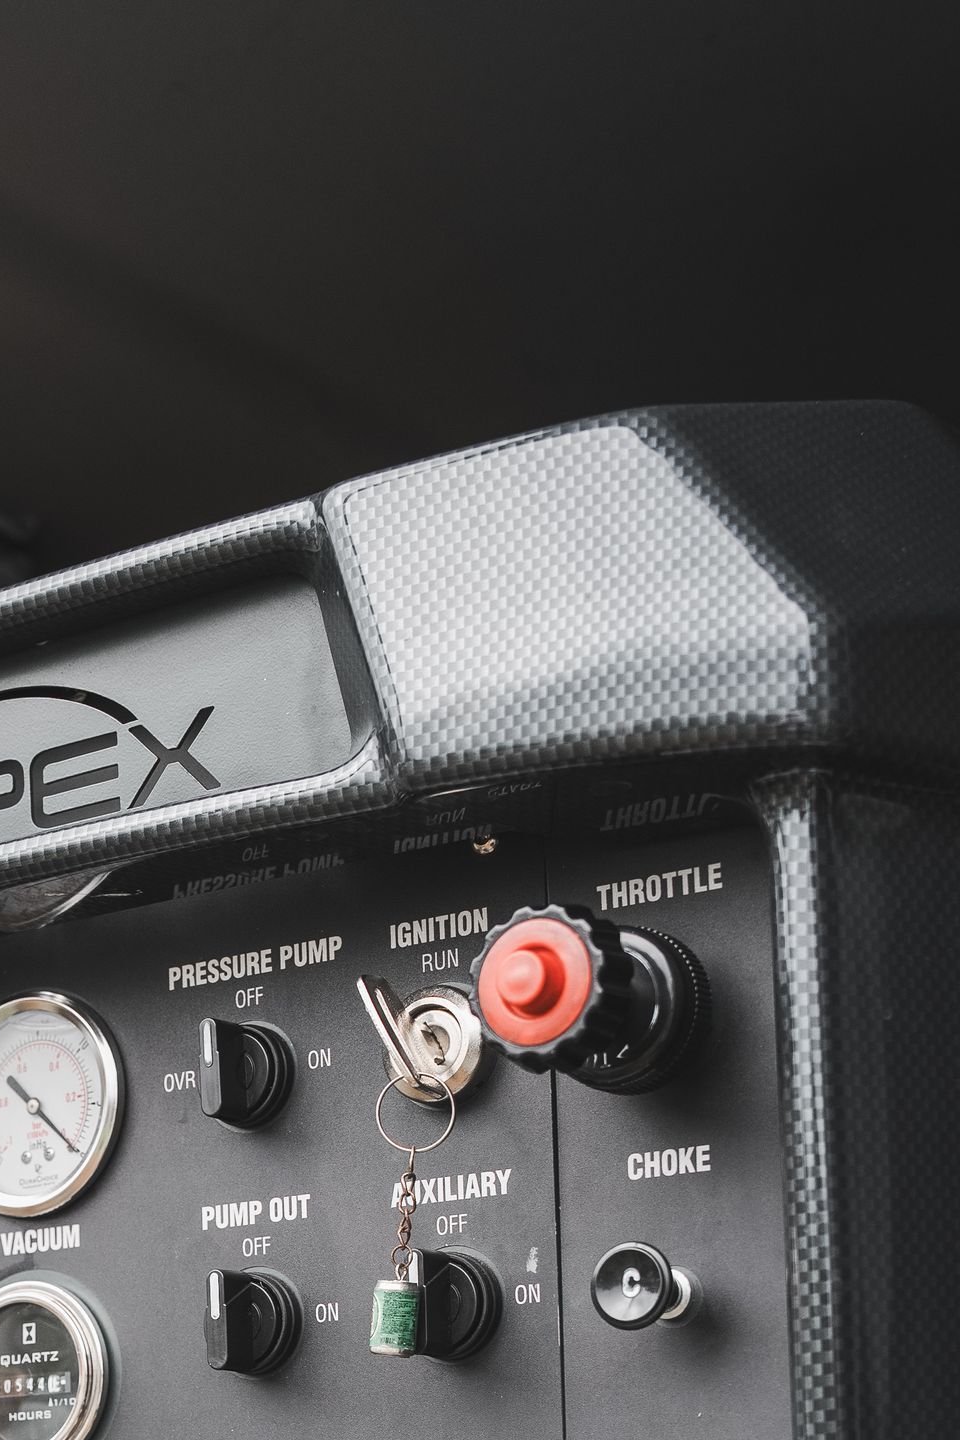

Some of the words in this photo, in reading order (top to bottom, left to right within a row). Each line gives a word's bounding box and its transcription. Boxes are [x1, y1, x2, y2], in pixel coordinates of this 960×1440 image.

[596, 862, 724, 912] THROTTLE
[389, 907, 489, 950] IGNITION
[168, 949, 273, 991] PRESSURE
[279, 936, 344, 974] PUMP
[421, 947, 460, 974] RUN
[235, 986, 265, 1009] OFF
[307, 1048, 332, 1070] ON
[163, 1070, 196, 1094] OVR
[626, 1144, 712, 1181] CHOKE
[391, 1168, 512, 1208] AUXILIARY
[201, 1202, 263, 1231] PUMP
[268, 1195, 311, 1223] OUT
[436, 1213, 468, 1236] OFF
[0, 1224, 81, 1256] VACUUM
[241, 1236, 272, 1259] OFF
[514, 1283, 541, 1305] ON
[315, 1302, 340, 1324] ON
[0, 1351, 60, 1368] QUARTZ
[8, 1410, 52, 1422] HOURS
